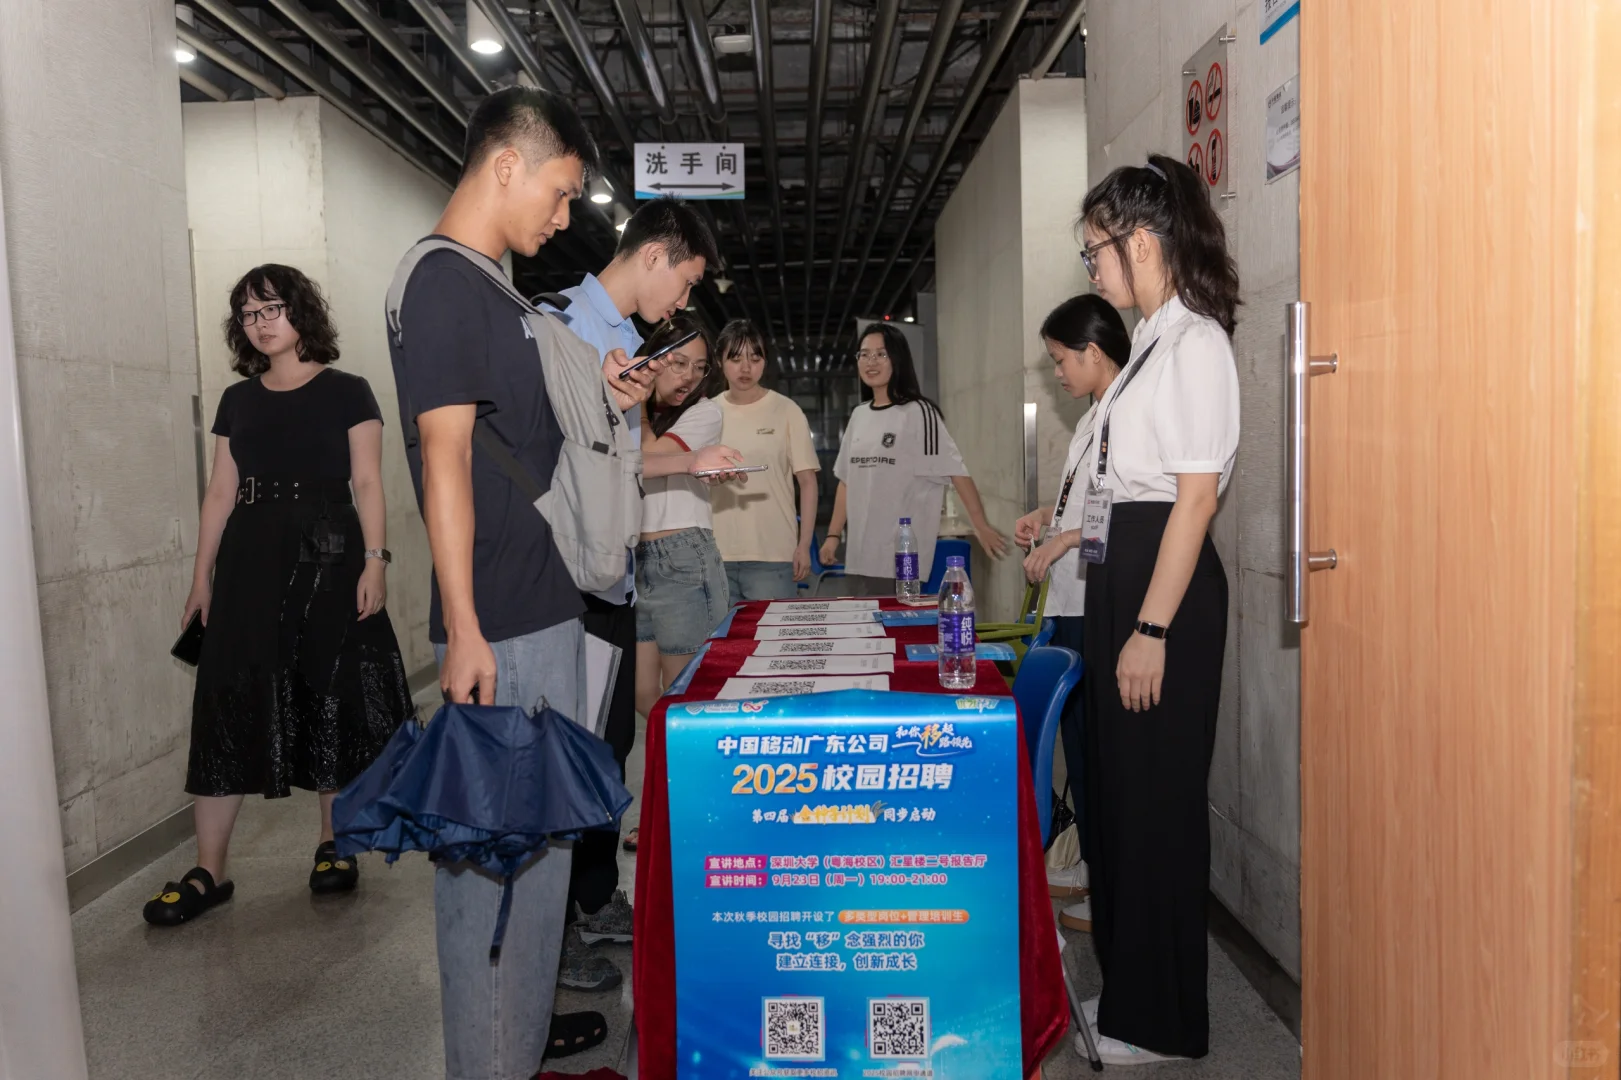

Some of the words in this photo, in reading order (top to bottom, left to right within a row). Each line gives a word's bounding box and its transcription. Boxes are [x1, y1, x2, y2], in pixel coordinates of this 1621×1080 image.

[646, 152, 737, 175] 洗手间
[961, 616, 972, 646] 纯悦
[717, 734, 889, 755] 中国移动广东公司
[752, 808, 789, 823] 第四届
[883, 808, 937, 822] 同步启动
[712, 911, 835, 923] 本次秋季校园招聘开设了
[776, 953, 917, 971] 建立连接，创新成长
